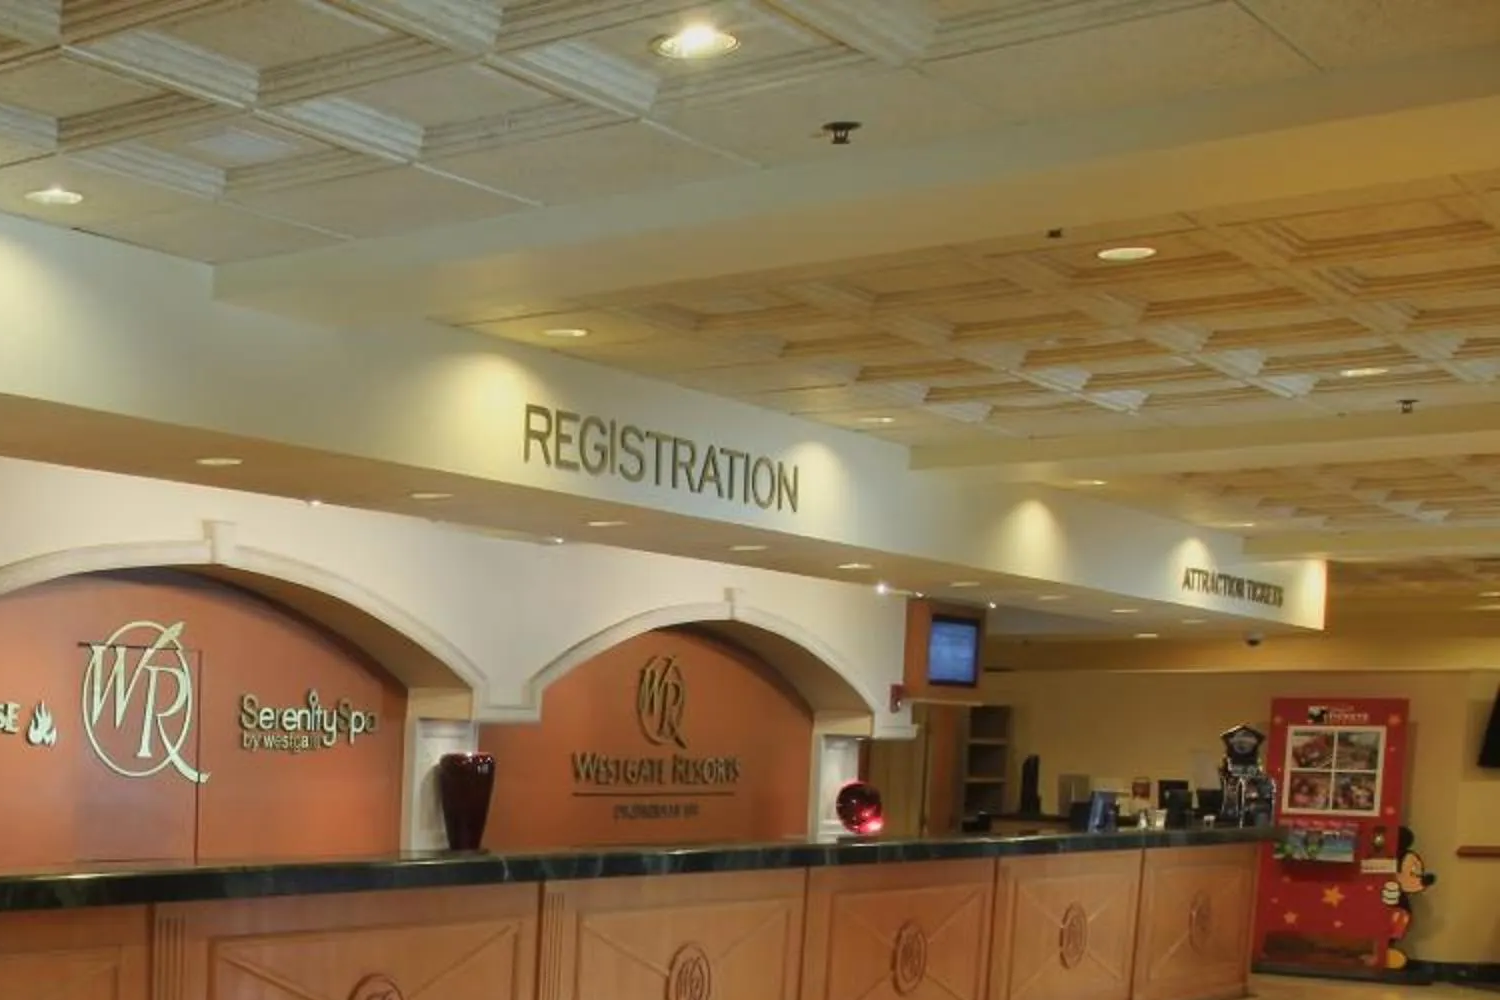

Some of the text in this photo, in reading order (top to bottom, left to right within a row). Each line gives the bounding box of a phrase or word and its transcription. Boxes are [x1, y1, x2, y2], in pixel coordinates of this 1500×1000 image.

[523, 403, 799, 513] REGISTRATION
[1182, 567, 1244, 598] ATTRACTION
[243, 731, 260, 752] by
[572, 751, 665, 786] WESTGATE
